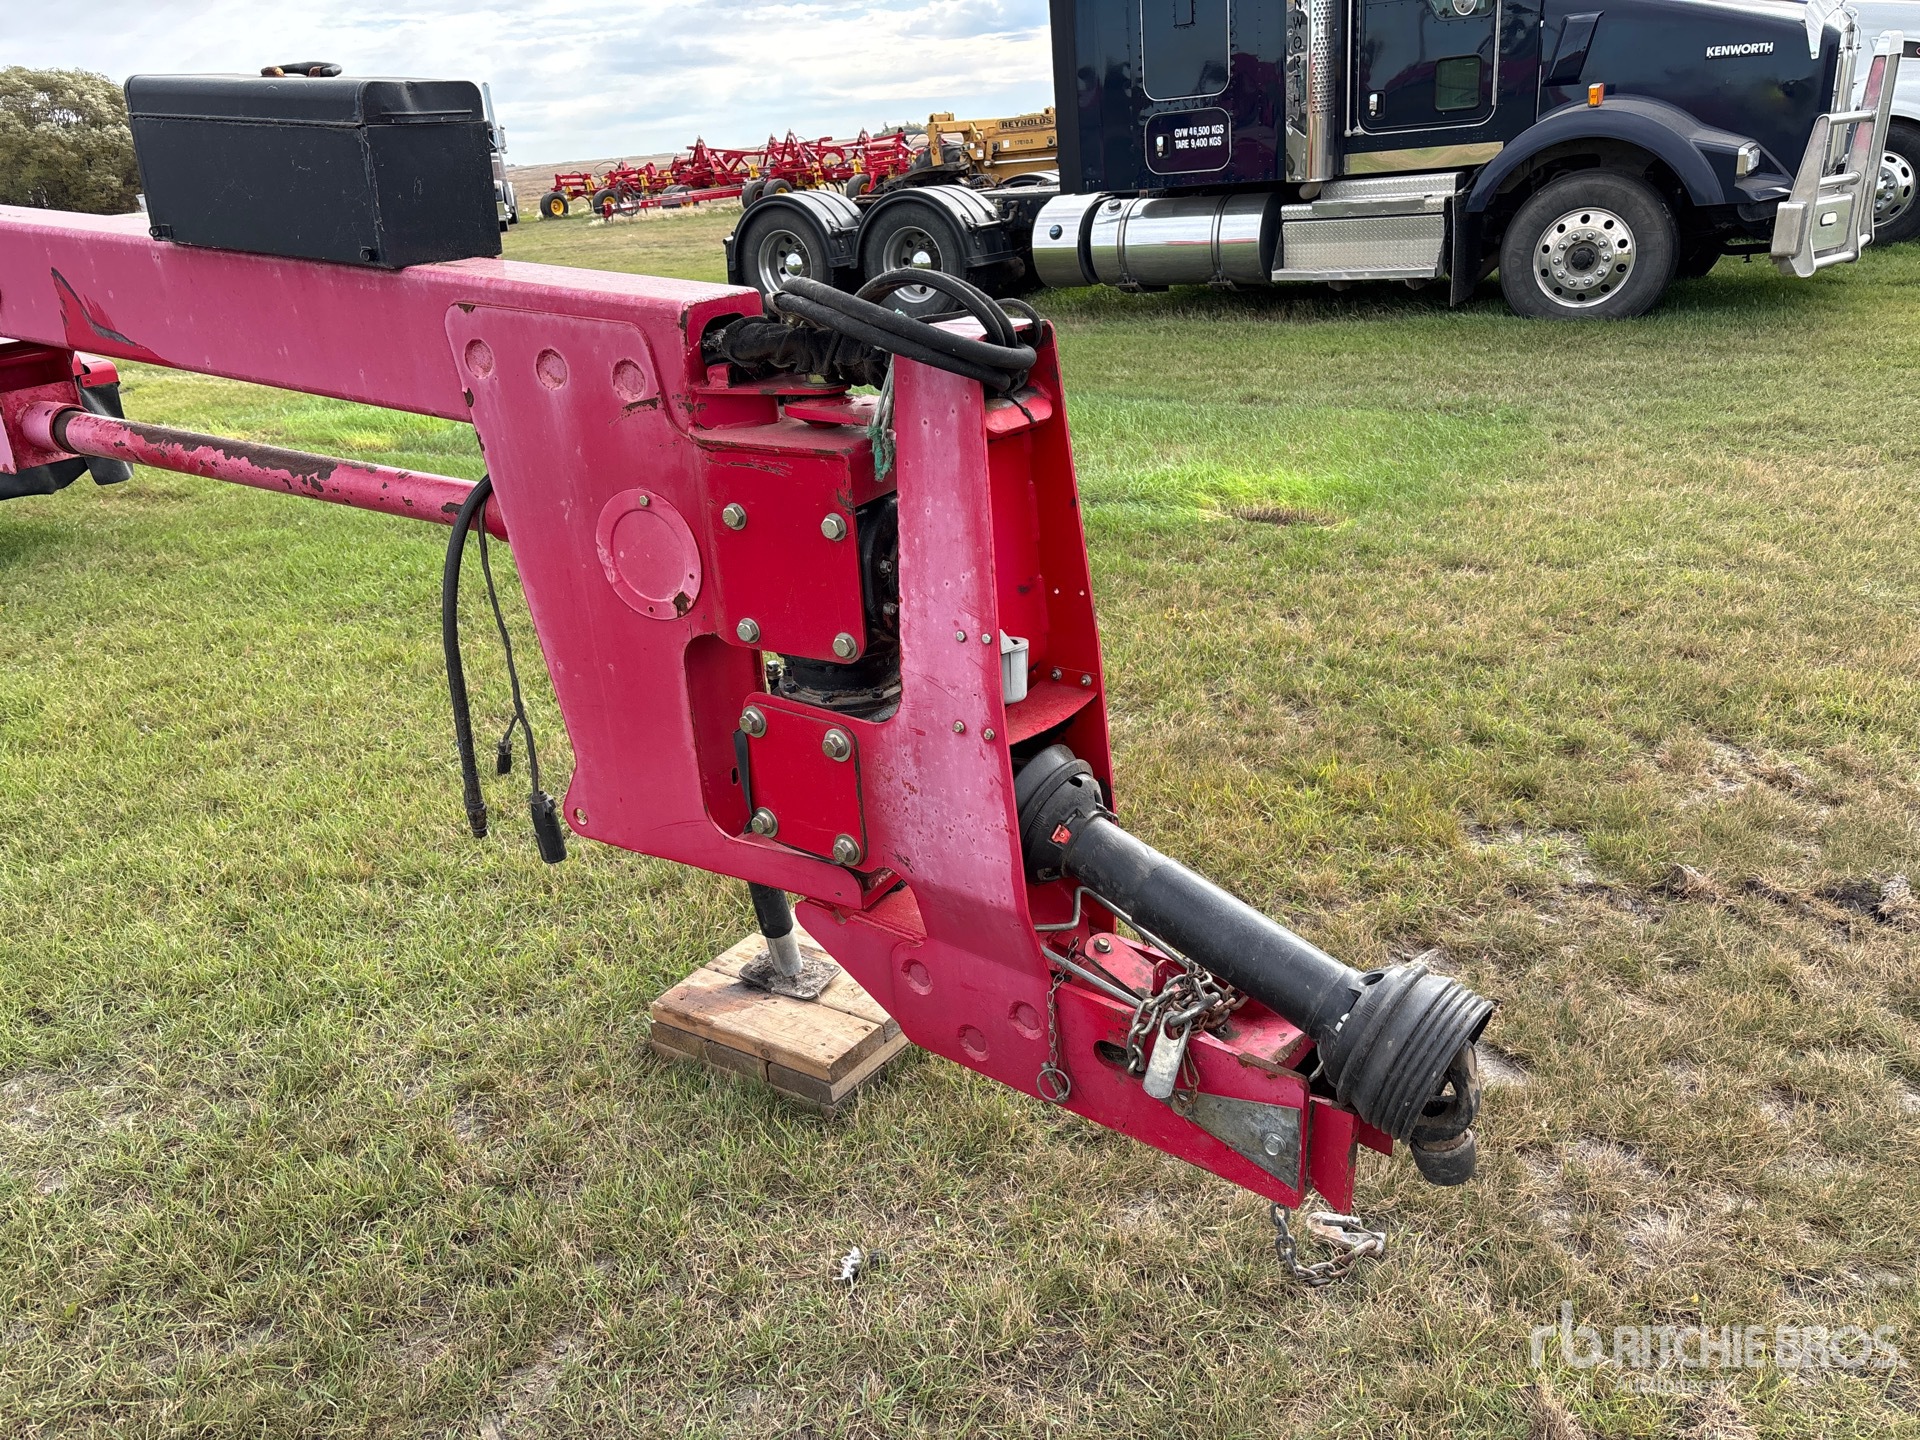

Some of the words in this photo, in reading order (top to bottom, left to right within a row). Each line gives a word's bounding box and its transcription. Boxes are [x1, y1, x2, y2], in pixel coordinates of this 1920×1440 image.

[1706, 42, 1774, 57] KENWORTH
[1001, 117, 1052, 129] REYNOLDS
[1174, 128, 1188, 138] GVW
[1211, 124, 1224, 134] KGS
[1174, 139, 1190, 149] TARE
[1191, 138, 1208, 149] 9,400
[1208, 136, 1222, 146] KGS
